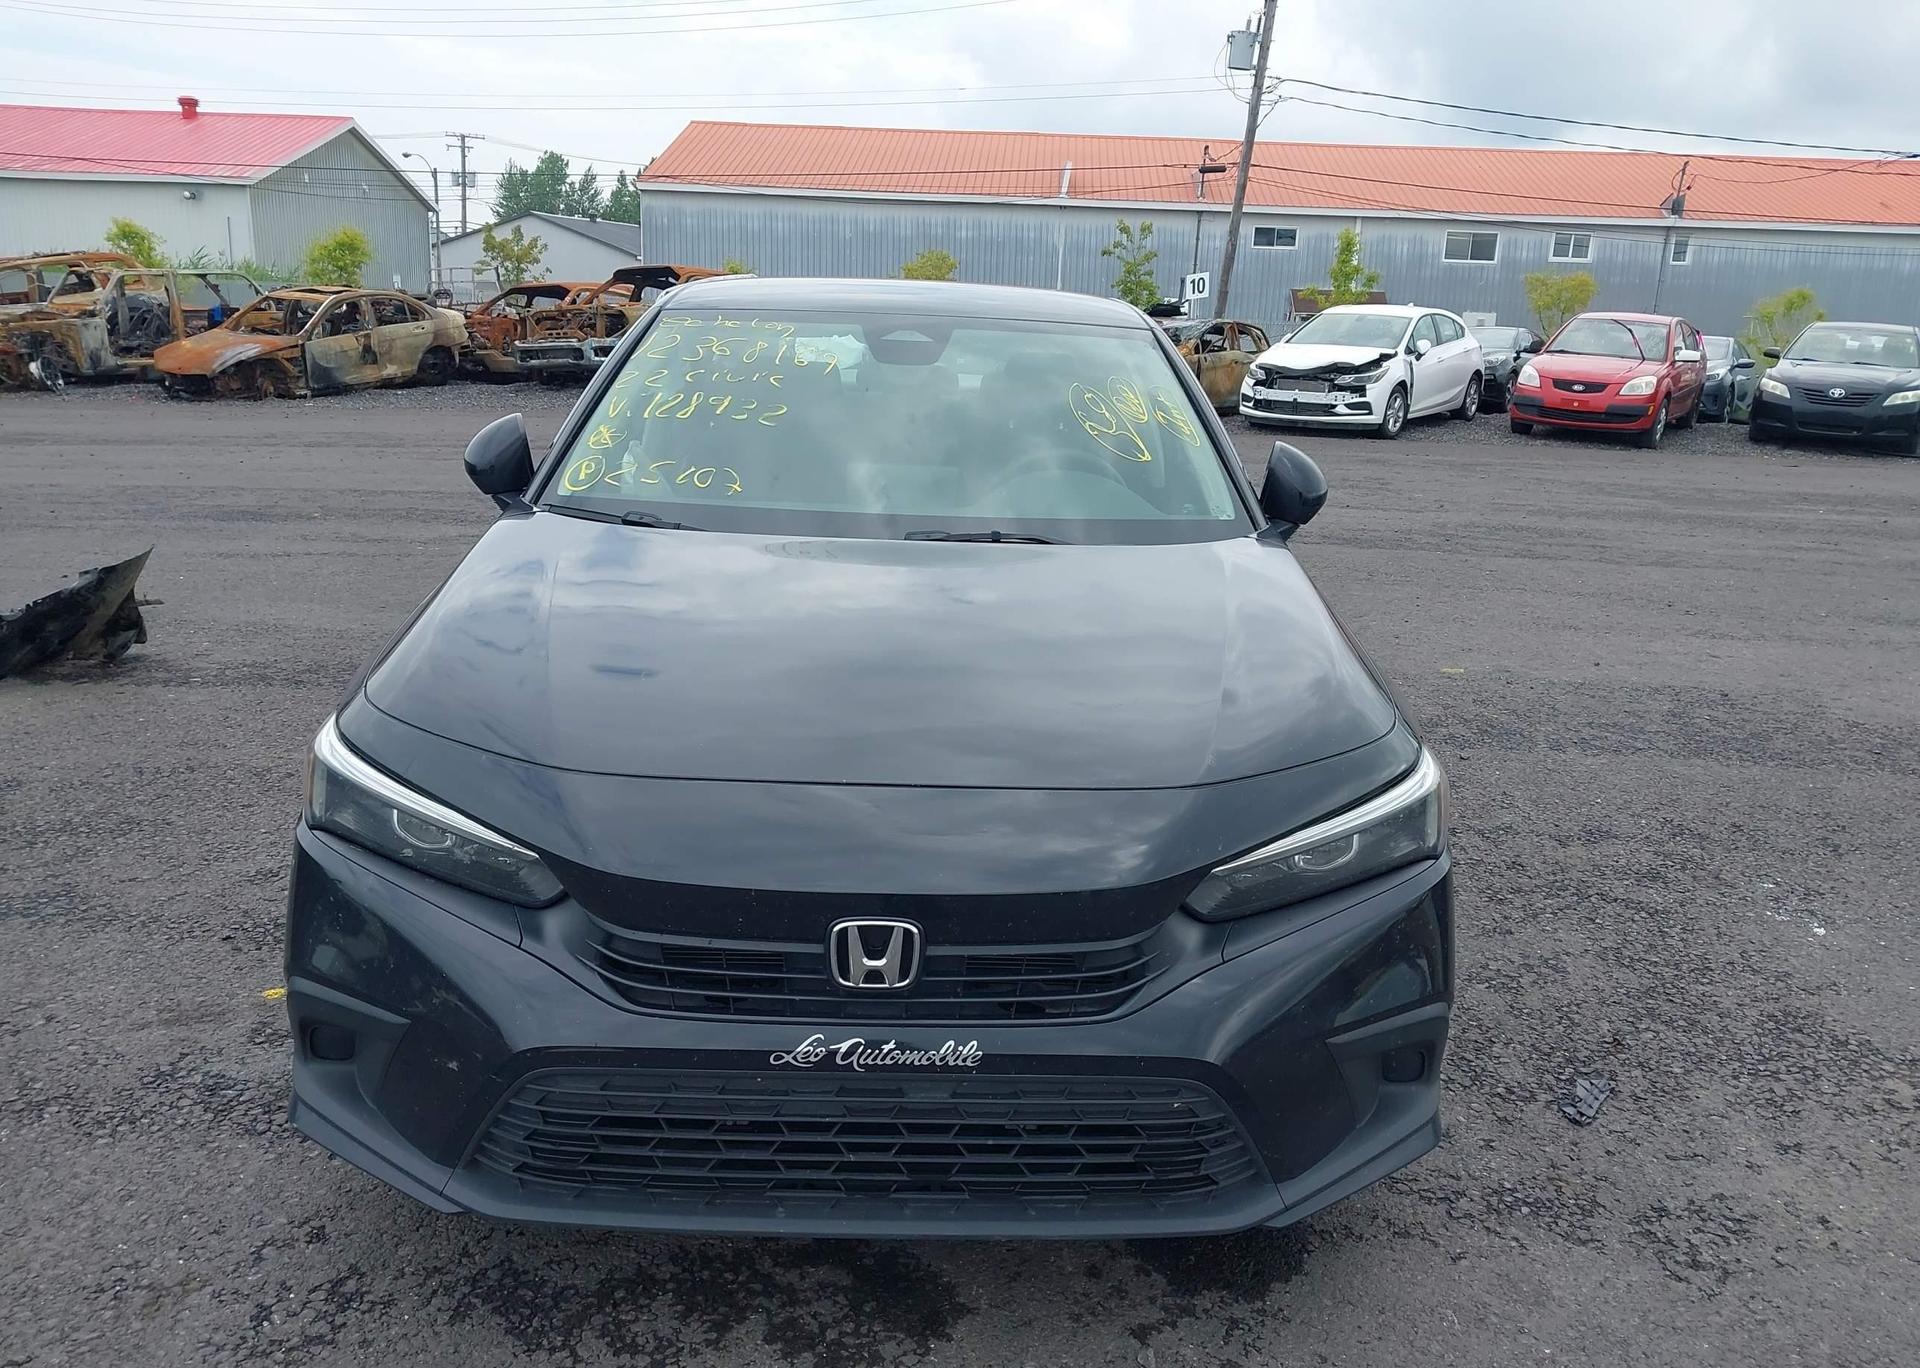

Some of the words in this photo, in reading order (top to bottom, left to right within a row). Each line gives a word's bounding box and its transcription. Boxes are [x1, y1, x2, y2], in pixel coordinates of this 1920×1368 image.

[1189, 277, 1206, 295] 10
[769, 1033, 829, 1067] Léo
[829, 1037, 984, 1072] Automobile
